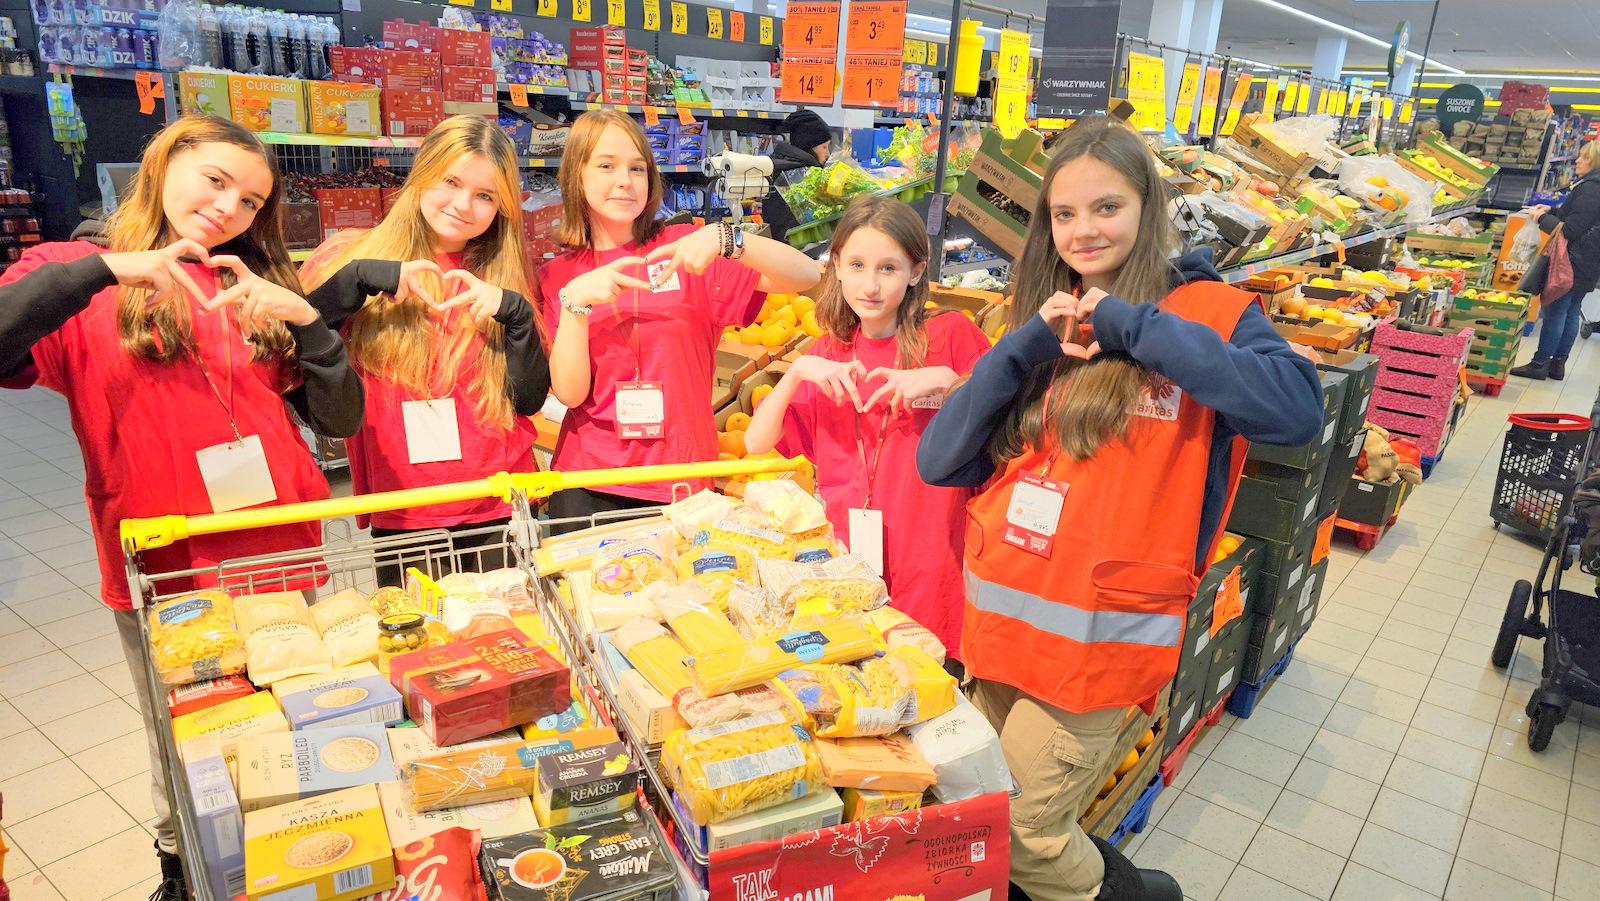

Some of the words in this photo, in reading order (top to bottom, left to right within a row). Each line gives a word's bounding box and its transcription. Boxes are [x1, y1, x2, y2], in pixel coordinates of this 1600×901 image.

[102, 10, 136, 25] DZIK
[805, 25, 814, 46] 4
[814, 25, 823, 35] 99
[869, 21, 877, 40] 3
[113, 51, 136, 64] DZI
[142, 39, 153, 62] DZIK
[187, 77, 216, 89] CUKIERKI
[246, 80, 297, 93] CUKIERKI
[799, 75, 815, 95] 14
[866, 78, 873, 98] 1
[1052, 80, 1106, 89] WARZYWNIAK
[312, 85, 324, 128] MIESZKO
[1445, 97, 1476, 107] SUSZONE
[1446, 104, 1472, 114] OWOCE
[914, 399, 940, 407] caritas
[1136, 402, 1174, 418] aritas
[322, 611, 369, 635] JĘCZMIENN
[474, 645, 491, 658] 2
[485, 649, 523, 666] 500
[505, 661, 542, 674] CENIE
[277, 753, 294, 769] RYŻ
[295, 737, 313, 782] PARBOILED
[558, 746, 607, 764] REMSEY
[558, 767, 585, 777] ANANAS
[569, 780, 623, 802] REMSEY
[289, 809, 339, 826] KASZA
[577, 805, 609, 818] ANANAS
[265, 811, 364, 842] JĘCZMIENNA
[598, 832, 632, 846] STRONG
[619, 836, 652, 852] EARL
[923, 828, 987, 849] OGÓLNOPOLSKA
[589, 843, 620, 861] GREY
[599, 850, 655, 877] Milton
[732, 868, 778, 901] TAK.
